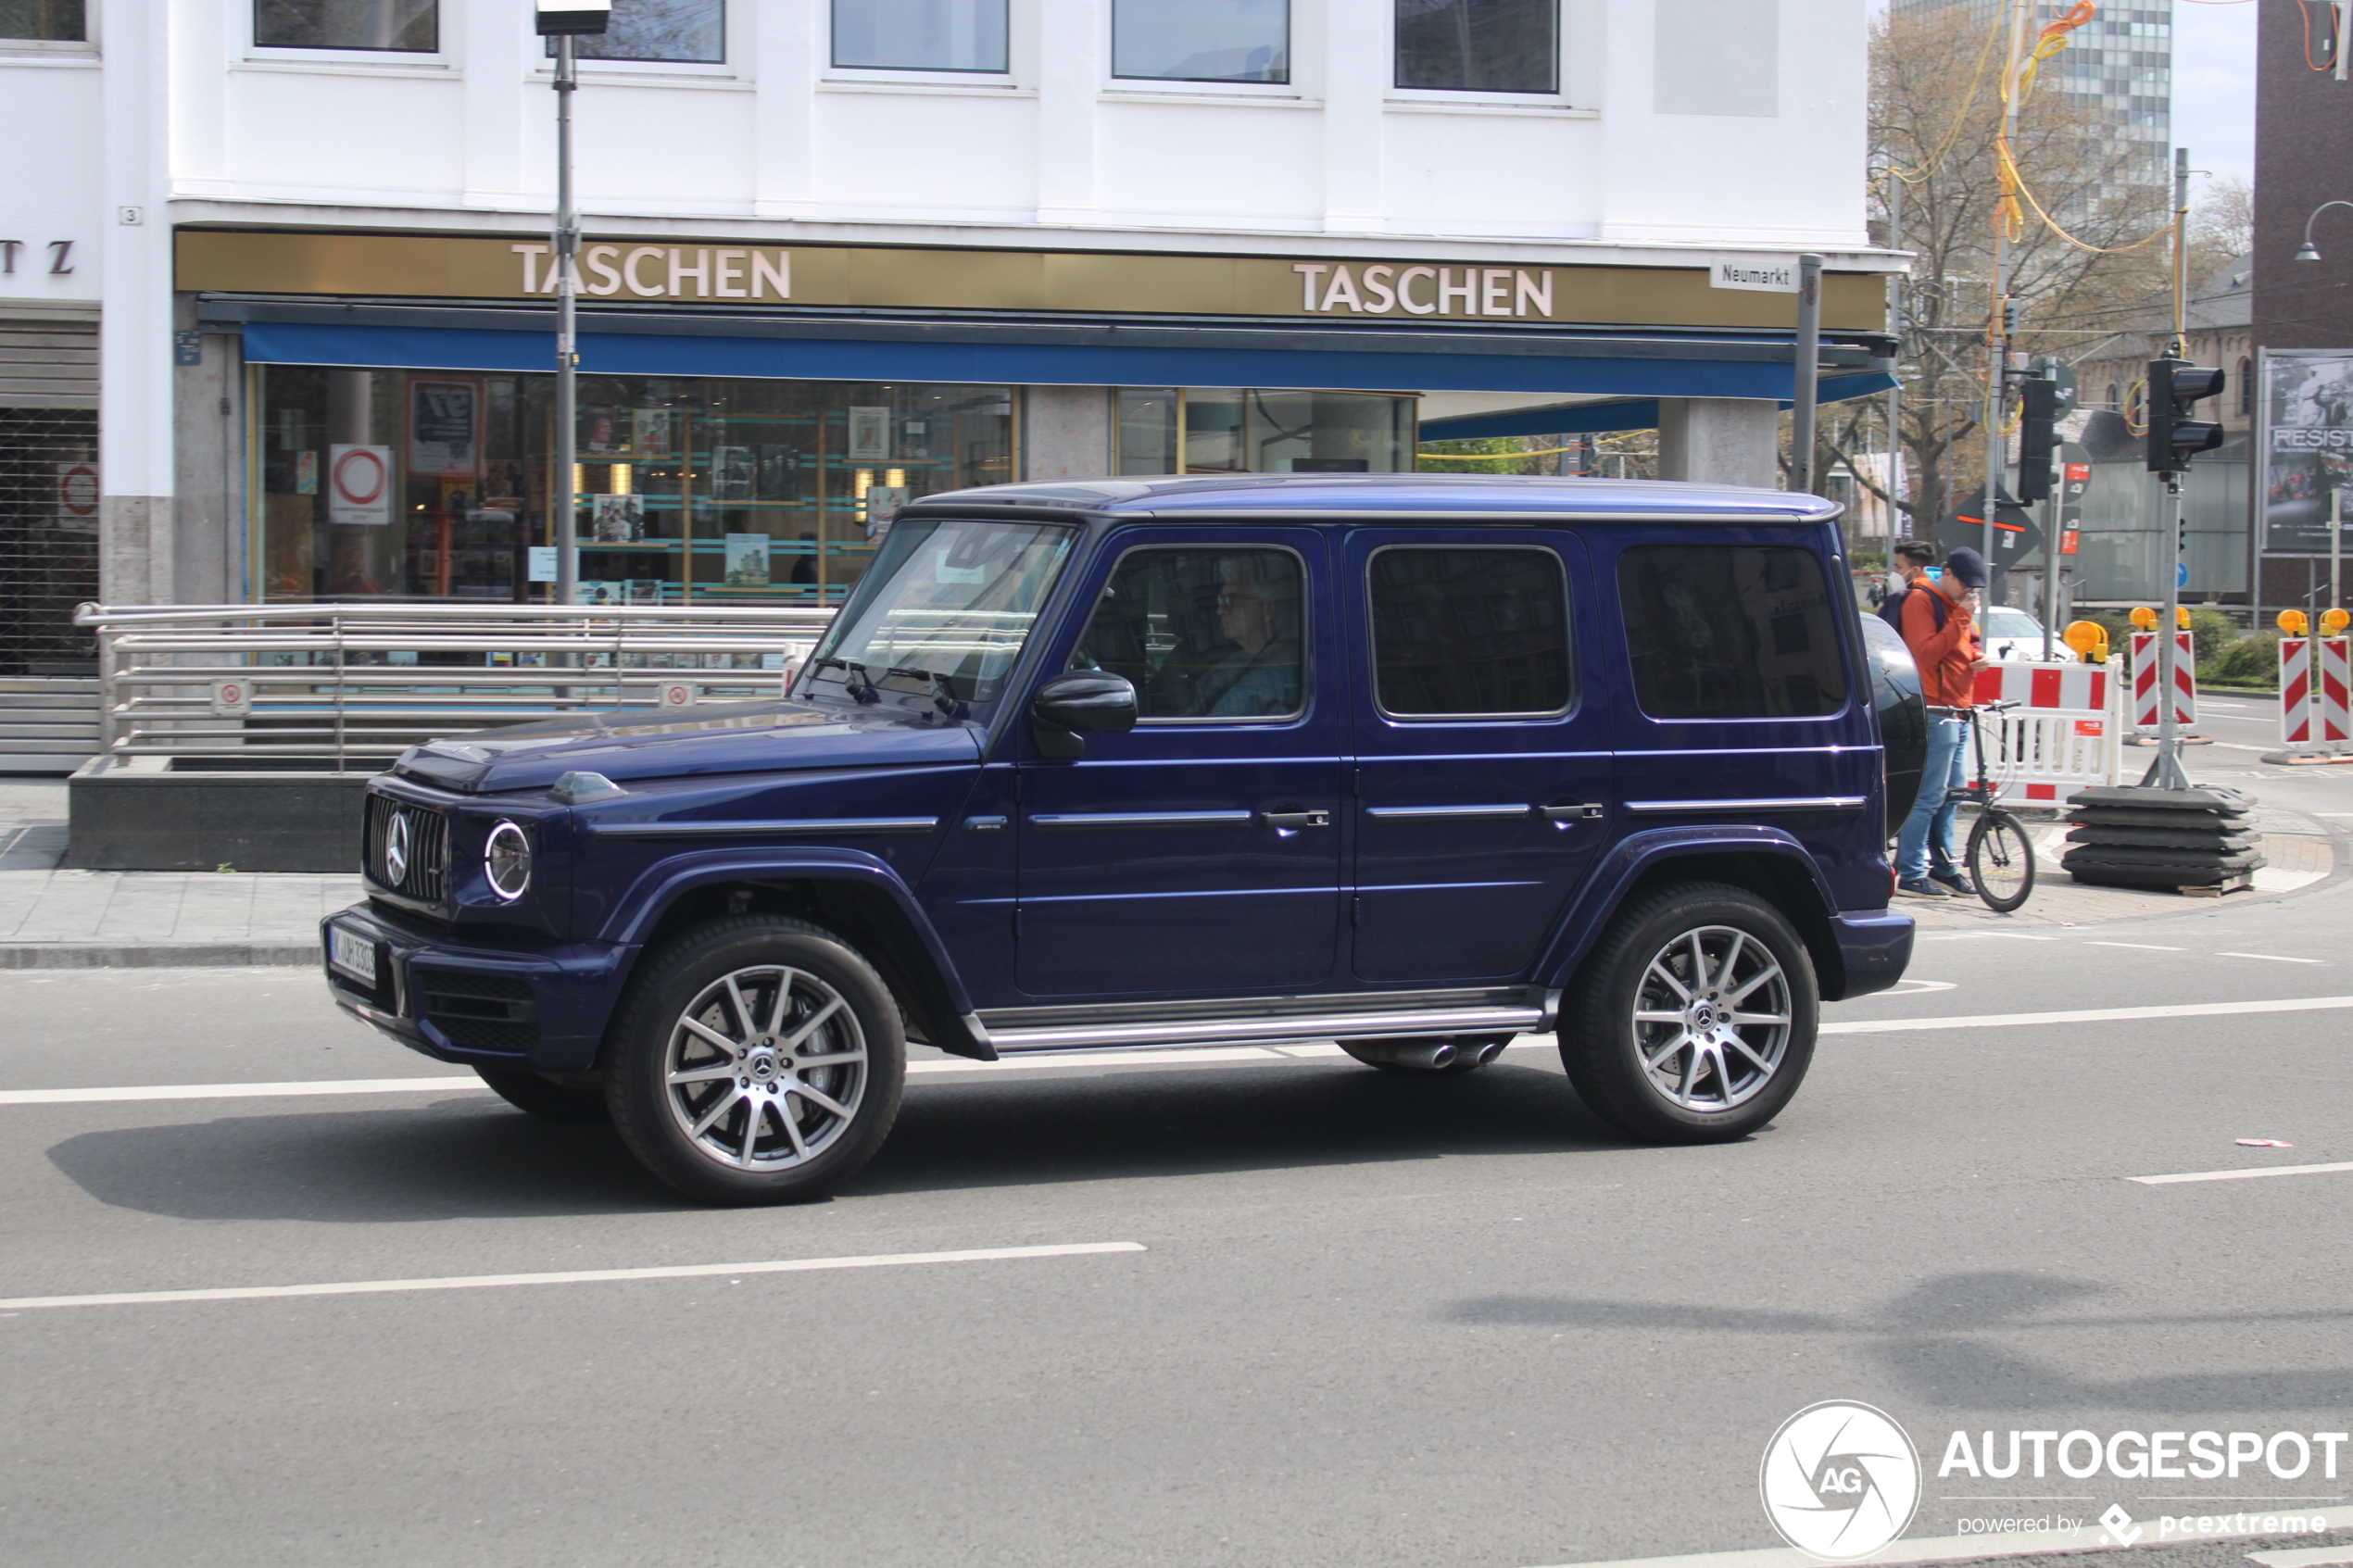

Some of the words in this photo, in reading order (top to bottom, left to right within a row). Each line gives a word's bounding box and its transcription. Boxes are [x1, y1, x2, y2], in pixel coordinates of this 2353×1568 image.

[126, 209, 136, 222] 3
[512, 245, 790, 299] TASCHEN
[1722, 264, 1790, 285] Neumarkt
[1292, 264, 1553, 318] TASCHEN
